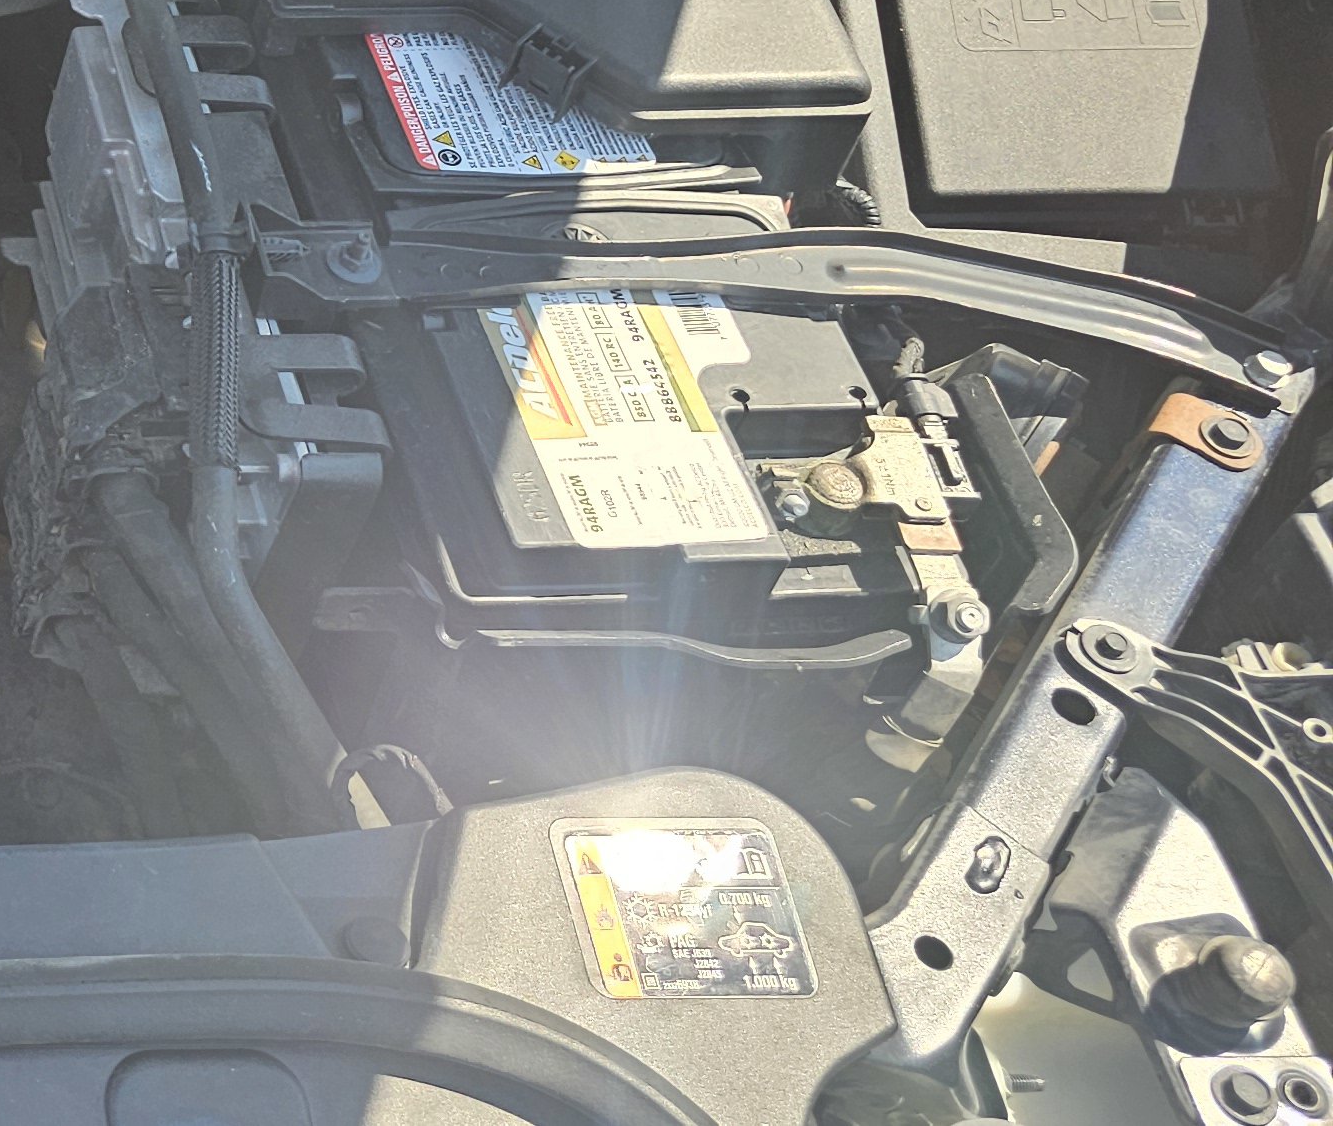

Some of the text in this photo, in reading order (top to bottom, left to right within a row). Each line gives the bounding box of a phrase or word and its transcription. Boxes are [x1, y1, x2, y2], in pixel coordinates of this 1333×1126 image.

[391, 85, 431, 152] DANGER/POISON
[608, 288, 645, 341] 94RAGM
[601, 337, 615, 348] RC
[554, 330, 593, 397] MAINTENANCE
[577, 359, 595, 380] SANS
[621, 379, 638, 396] CA
[567, 474, 604, 532] 94RAGM
[718, 892, 772, 907] 0.700 kg
[743, 974, 800, 991] 1.000 kg
